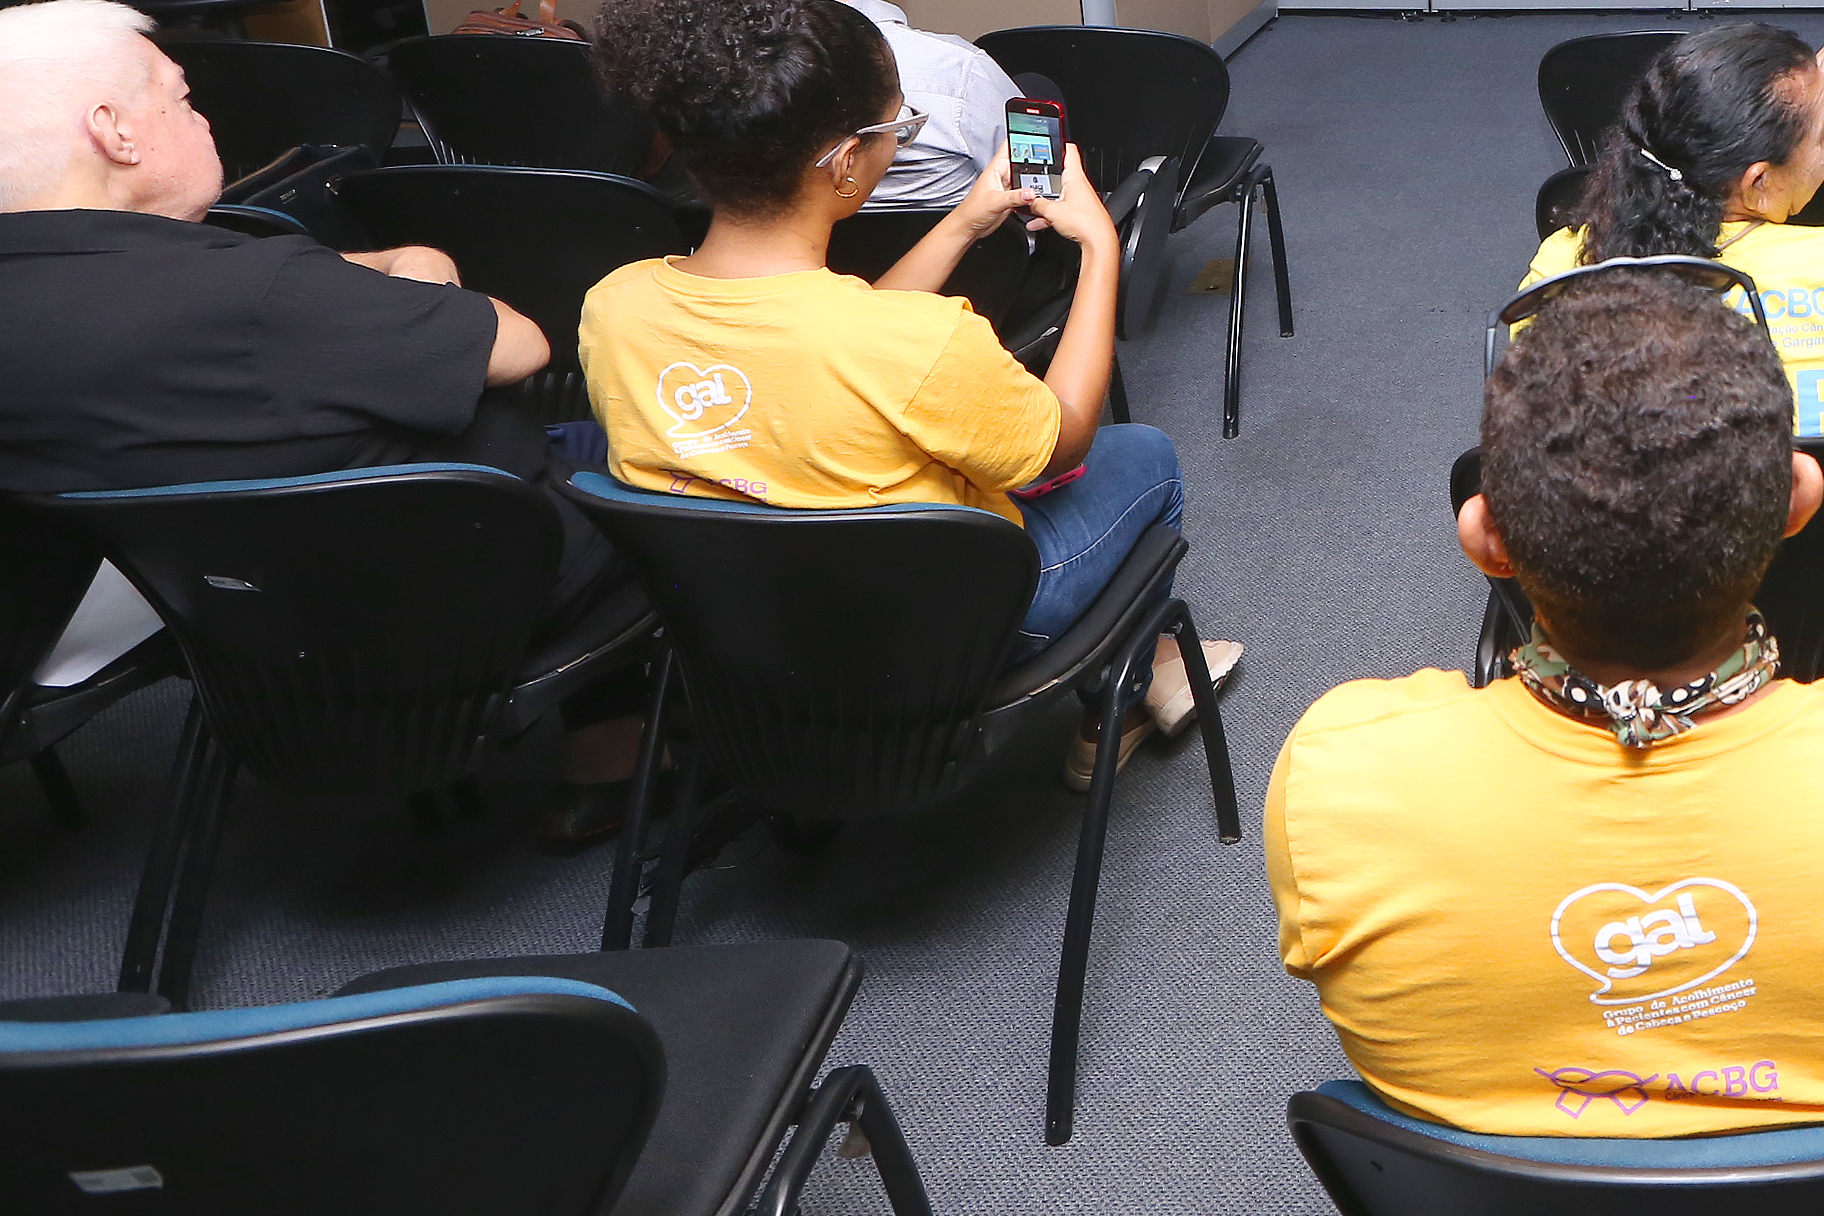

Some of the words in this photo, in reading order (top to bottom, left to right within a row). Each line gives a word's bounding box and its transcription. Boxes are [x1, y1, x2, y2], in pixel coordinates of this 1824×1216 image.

[674, 372, 732, 421] gal
[1593, 892, 1717, 979] gal
[1603, 1006, 1645, 1020] Grupo
[1650, 1000, 1667, 1011] de
[1672, 978, 1755, 1006] Acolhimento
[1616, 1007, 1681, 1026] Pacientes
[1681, 1000, 1710, 1013] com
[1710, 986, 1757, 1005] Câncer
[1617, 1024, 1635, 1036] de
[1635, 1015, 1683, 1030] Cabeça
[1683, 1013, 1692, 1022] e
[1693, 999, 1747, 1019] Pescoço
[1665, 1060, 1779, 1097] ACBG
